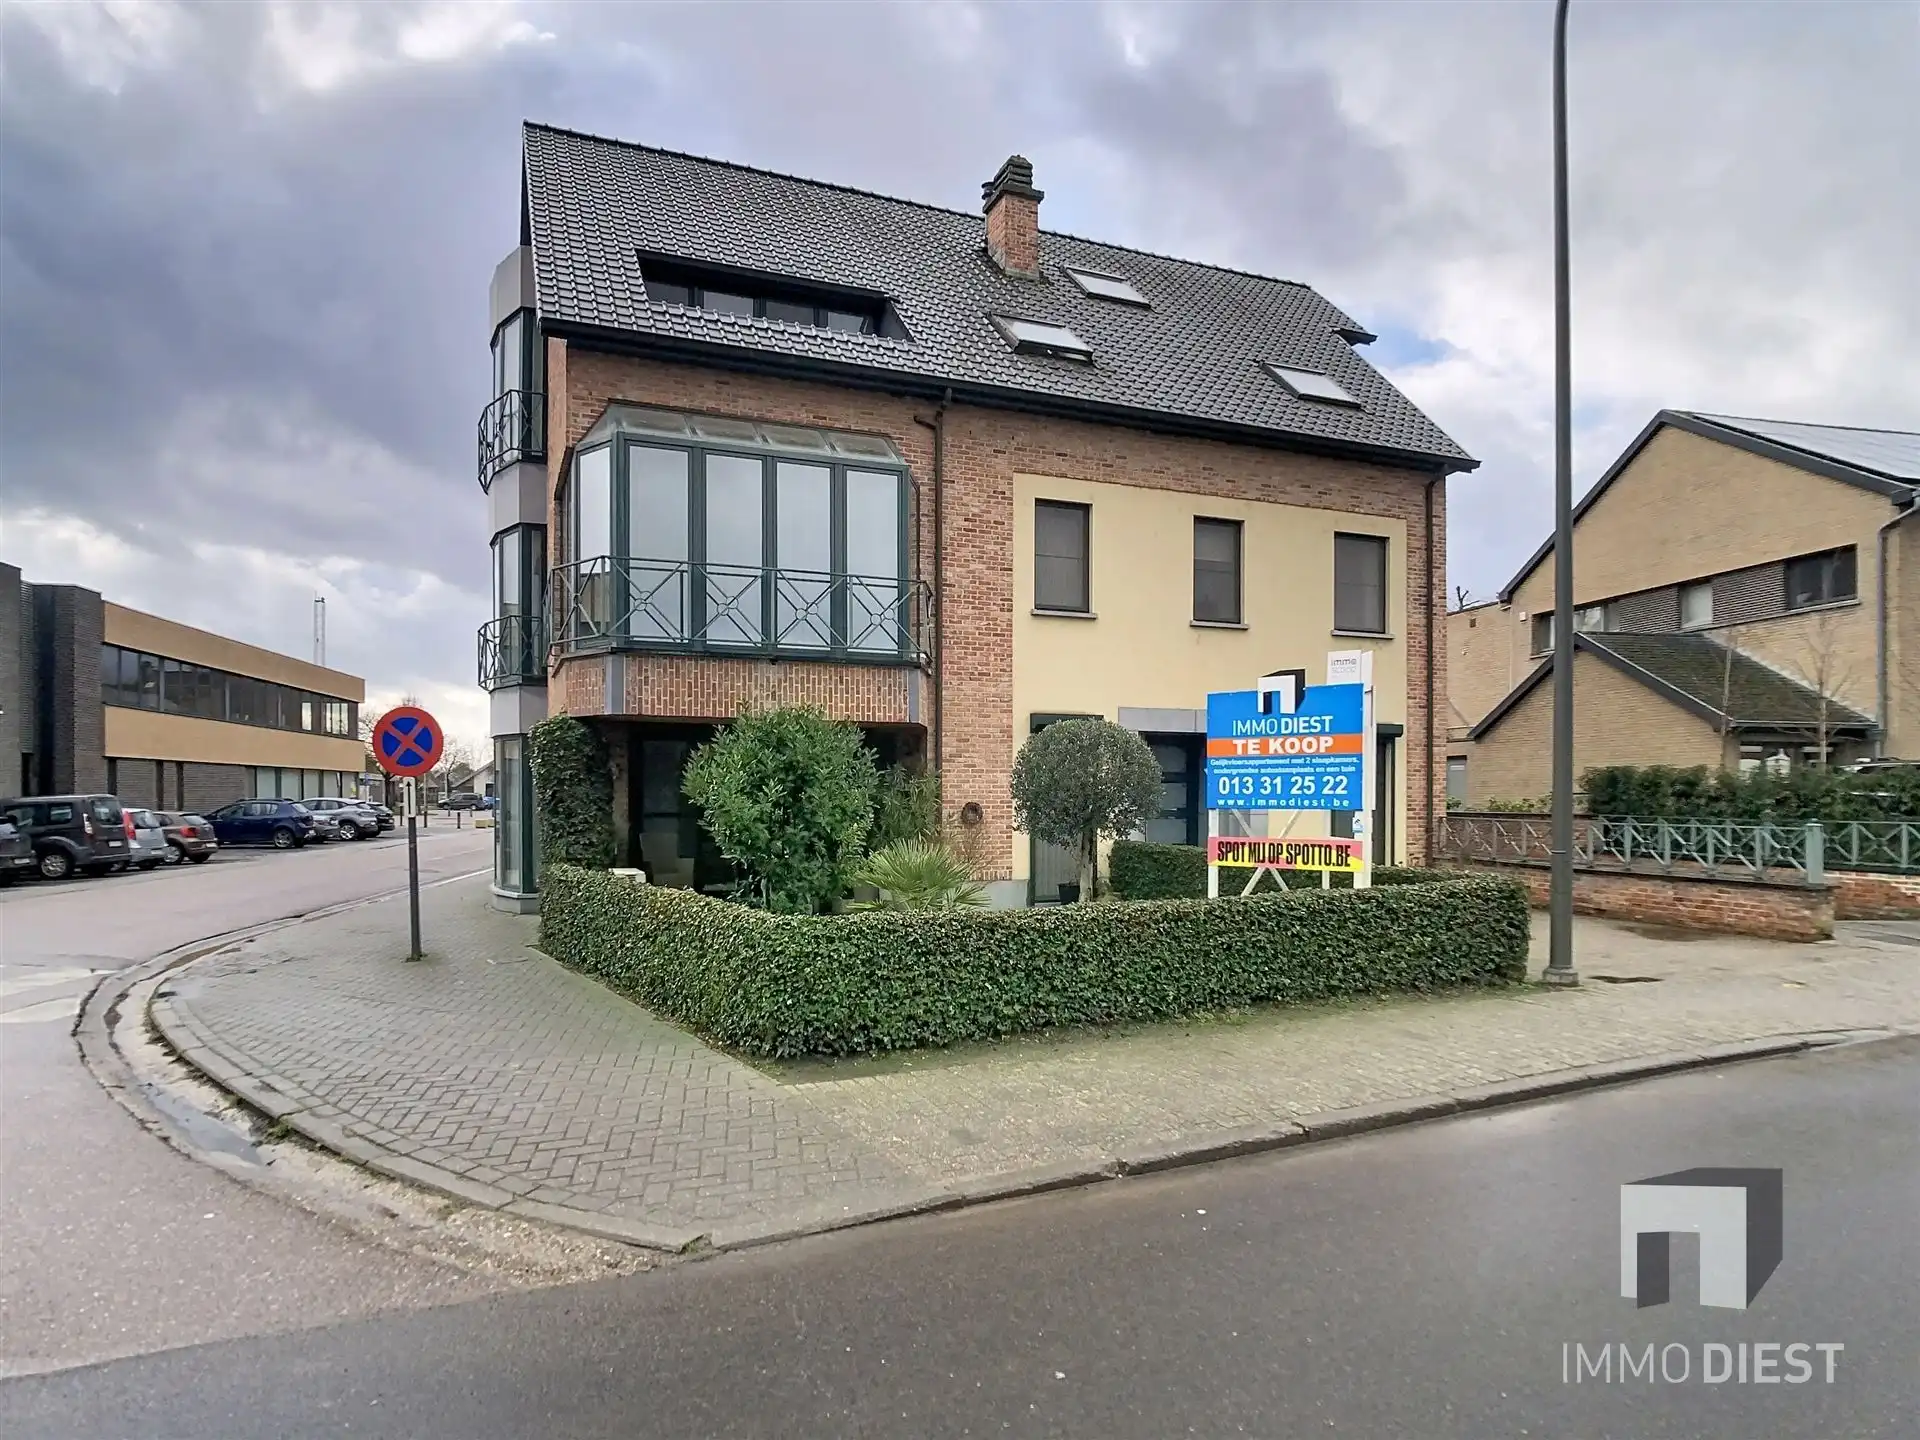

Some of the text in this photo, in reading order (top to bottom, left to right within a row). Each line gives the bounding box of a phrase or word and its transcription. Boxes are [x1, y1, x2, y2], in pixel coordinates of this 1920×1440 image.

[1232, 716, 1333, 736] IMMO DIEST
[1232, 736, 1334, 755] TE KOOP
[1218, 775, 1348, 795] 013 31 25 22
[1217, 797, 1350, 807] www.immodiest.be
[1217, 841, 1351, 867] SPOT MIJ OP SPOTTO.BE
